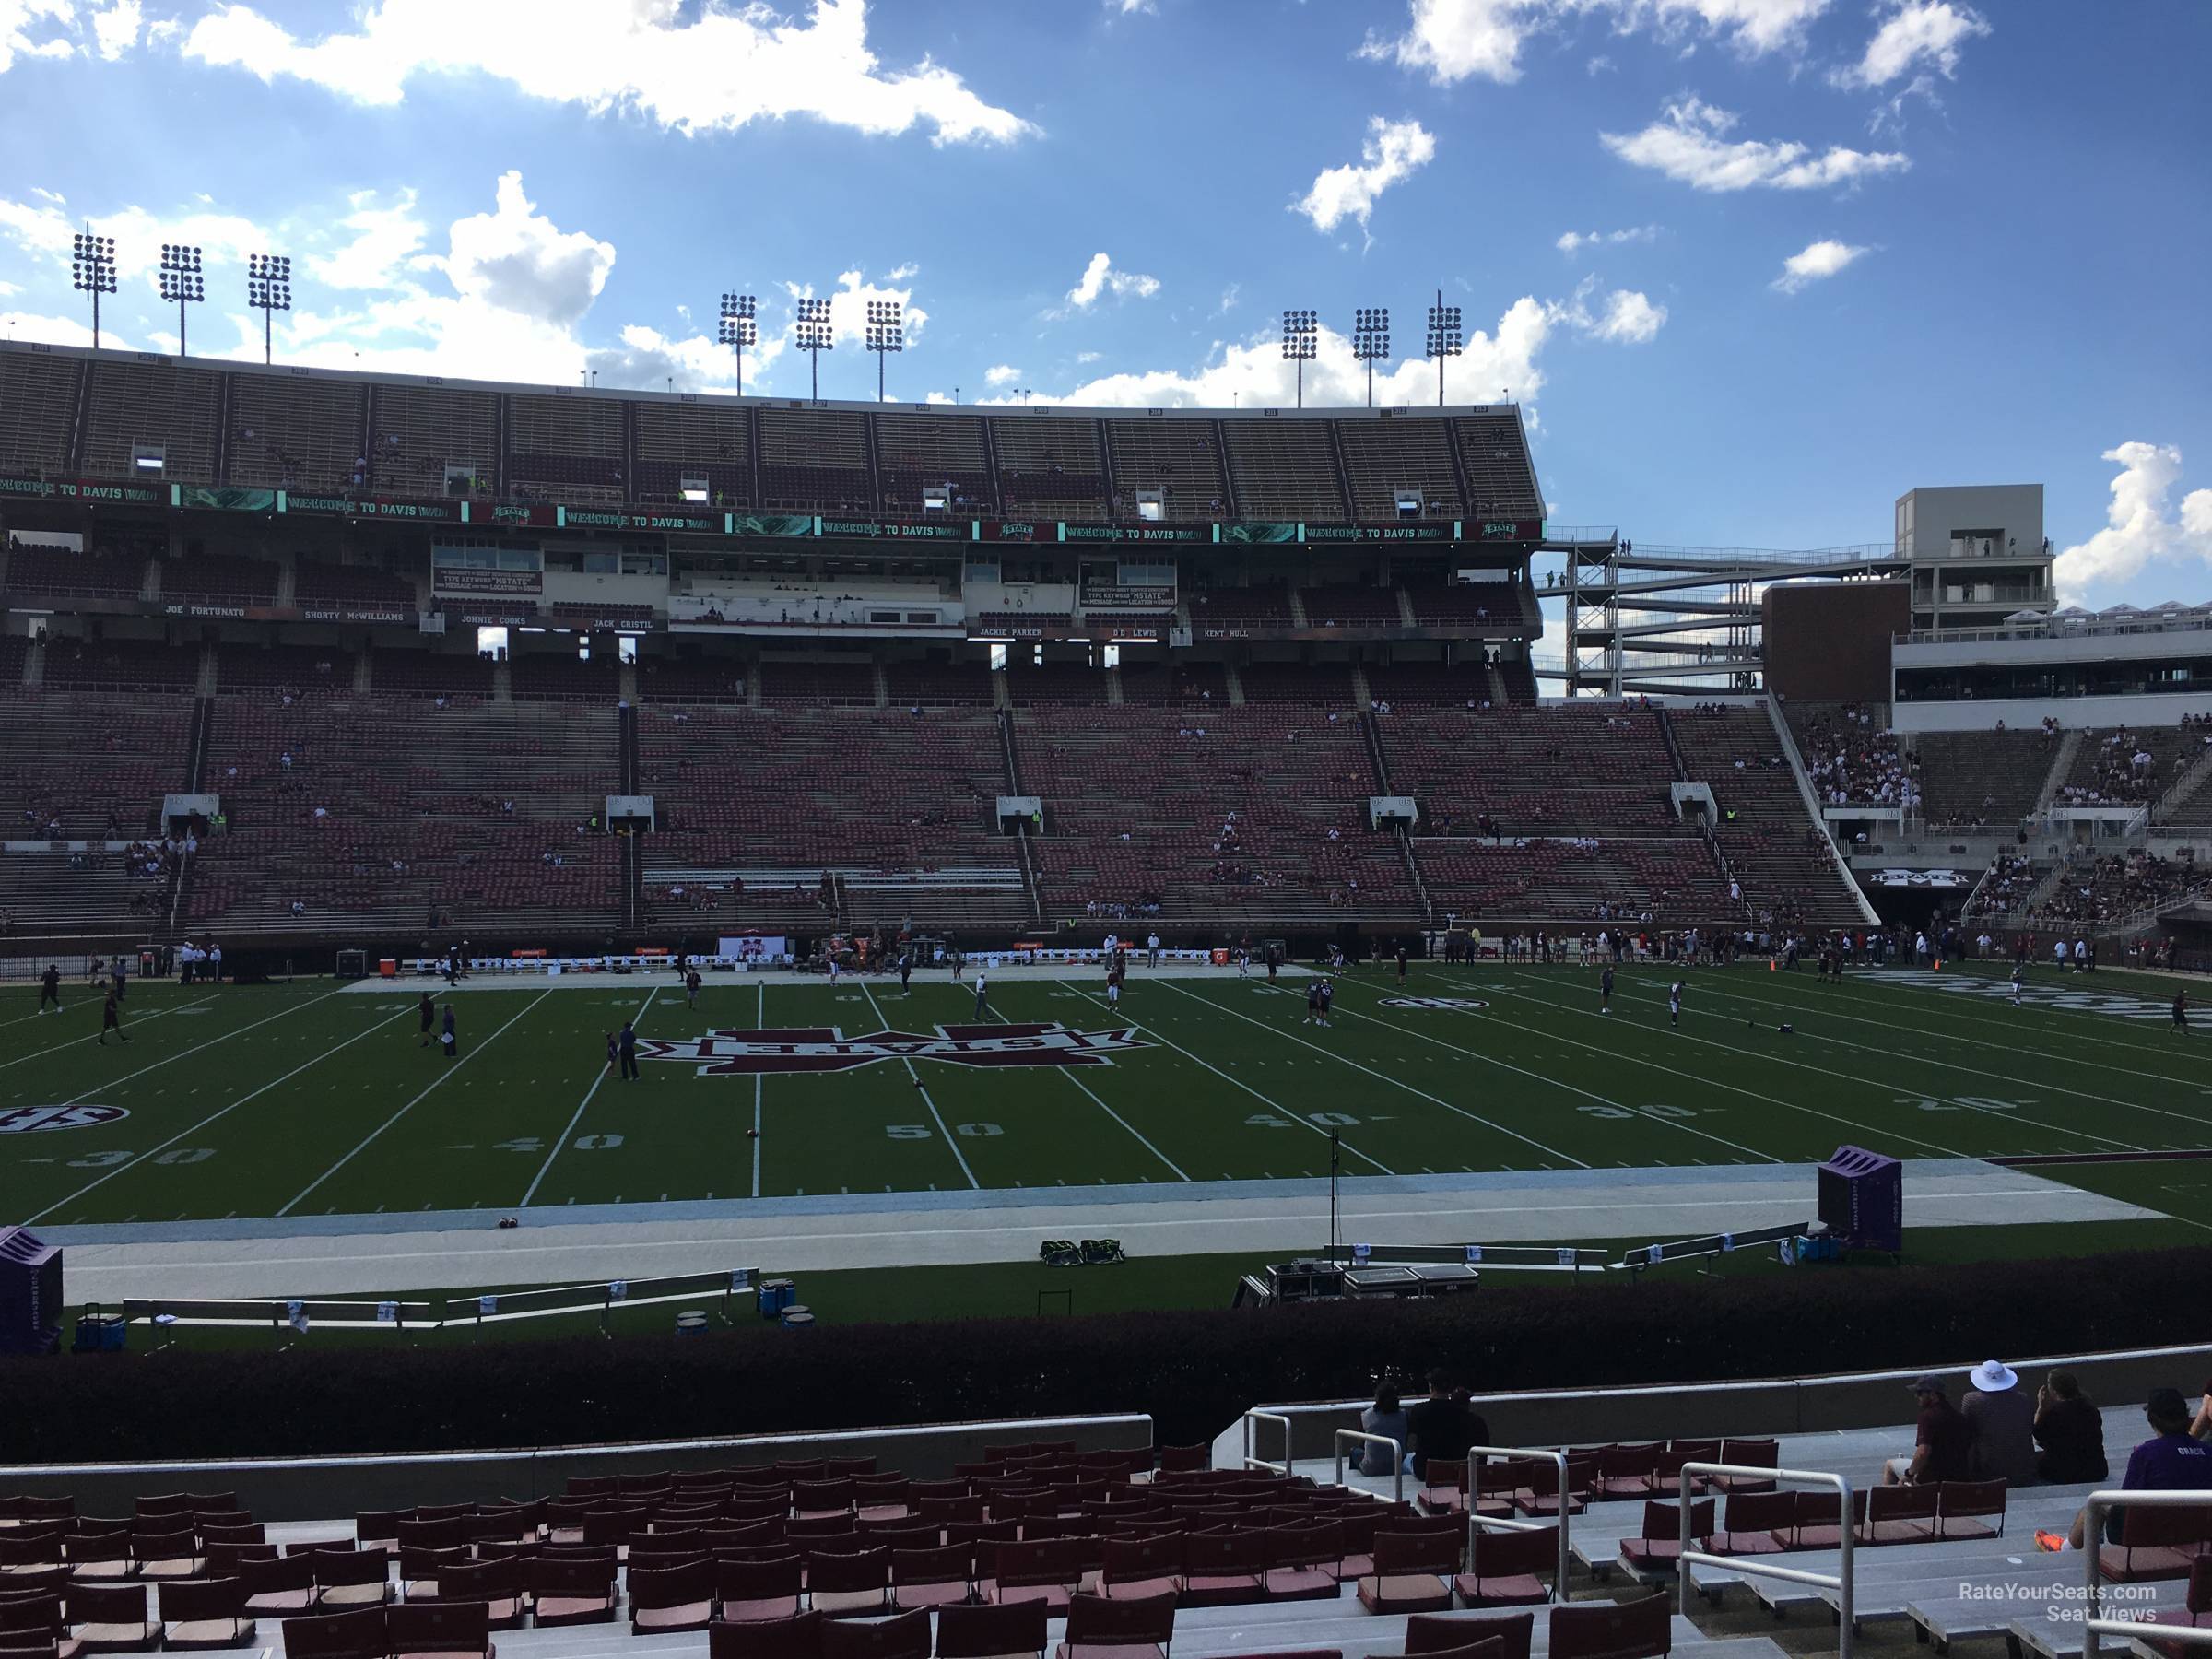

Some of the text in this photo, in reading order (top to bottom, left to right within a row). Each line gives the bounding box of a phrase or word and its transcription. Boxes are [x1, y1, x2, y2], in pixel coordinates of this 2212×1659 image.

[60, 484, 76, 496] TO
[83, 486, 122, 499] DAVIS
[288, 498, 355, 512] WELCOME
[360, 502, 375, 513] TO
[381, 504, 416, 516] DAVIS
[567, 512, 629, 526] WELCOME
[632, 516, 647, 527] TO
[652, 518, 684, 528] DAVIS
[823, 522, 881, 535] WELCOME
[885, 524, 899, 535] TO
[902, 526, 934, 536] DAVIS
[1066, 527, 1124, 539] WELCOME
[1126, 529, 1140, 539] TO
[1144, 529, 1174, 539] DAVIS
[1306, 528, 1363, 539] WELCOME
[1367, 529, 1380, 538] TO
[1384, 528, 1415, 538] DAVIS
[166, 606, 245, 618] JOE FORTUNATO
[305, 611, 404, 621] SHORTY McWILLIAMS
[462, 616, 526, 625] JOHNIE COOKS
[594, 619, 653, 629] JACK CRISTIL
[980, 628, 1007, 636] JACKIE
[1204, 629, 1249, 638] KENT HULL
[1216, 952, 1223, 960] G
[885, 1123, 1005, 1139] 50
[491, 1134, 626, 1153] 40
